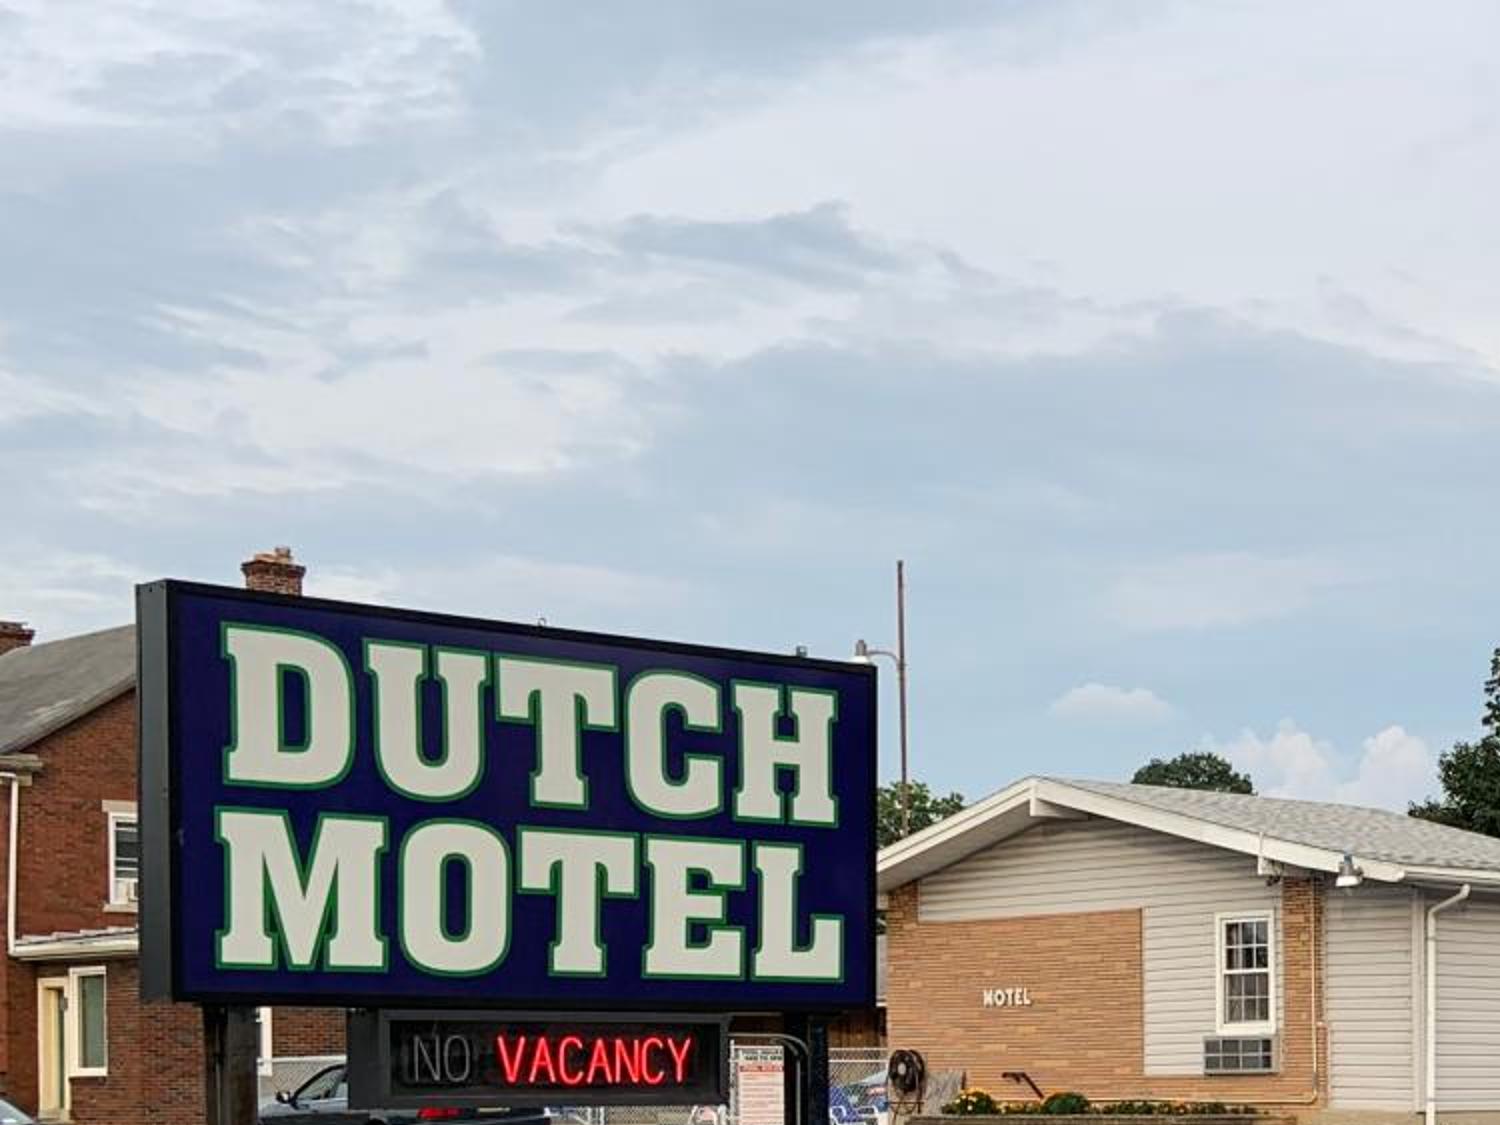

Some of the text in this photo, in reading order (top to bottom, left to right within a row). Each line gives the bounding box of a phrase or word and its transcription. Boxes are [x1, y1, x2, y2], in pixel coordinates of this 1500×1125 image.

[220, 621, 838, 826] DUTCH
[214, 805, 844, 981] MOTEL
[413, 1034, 692, 1085] NO VACANCY
